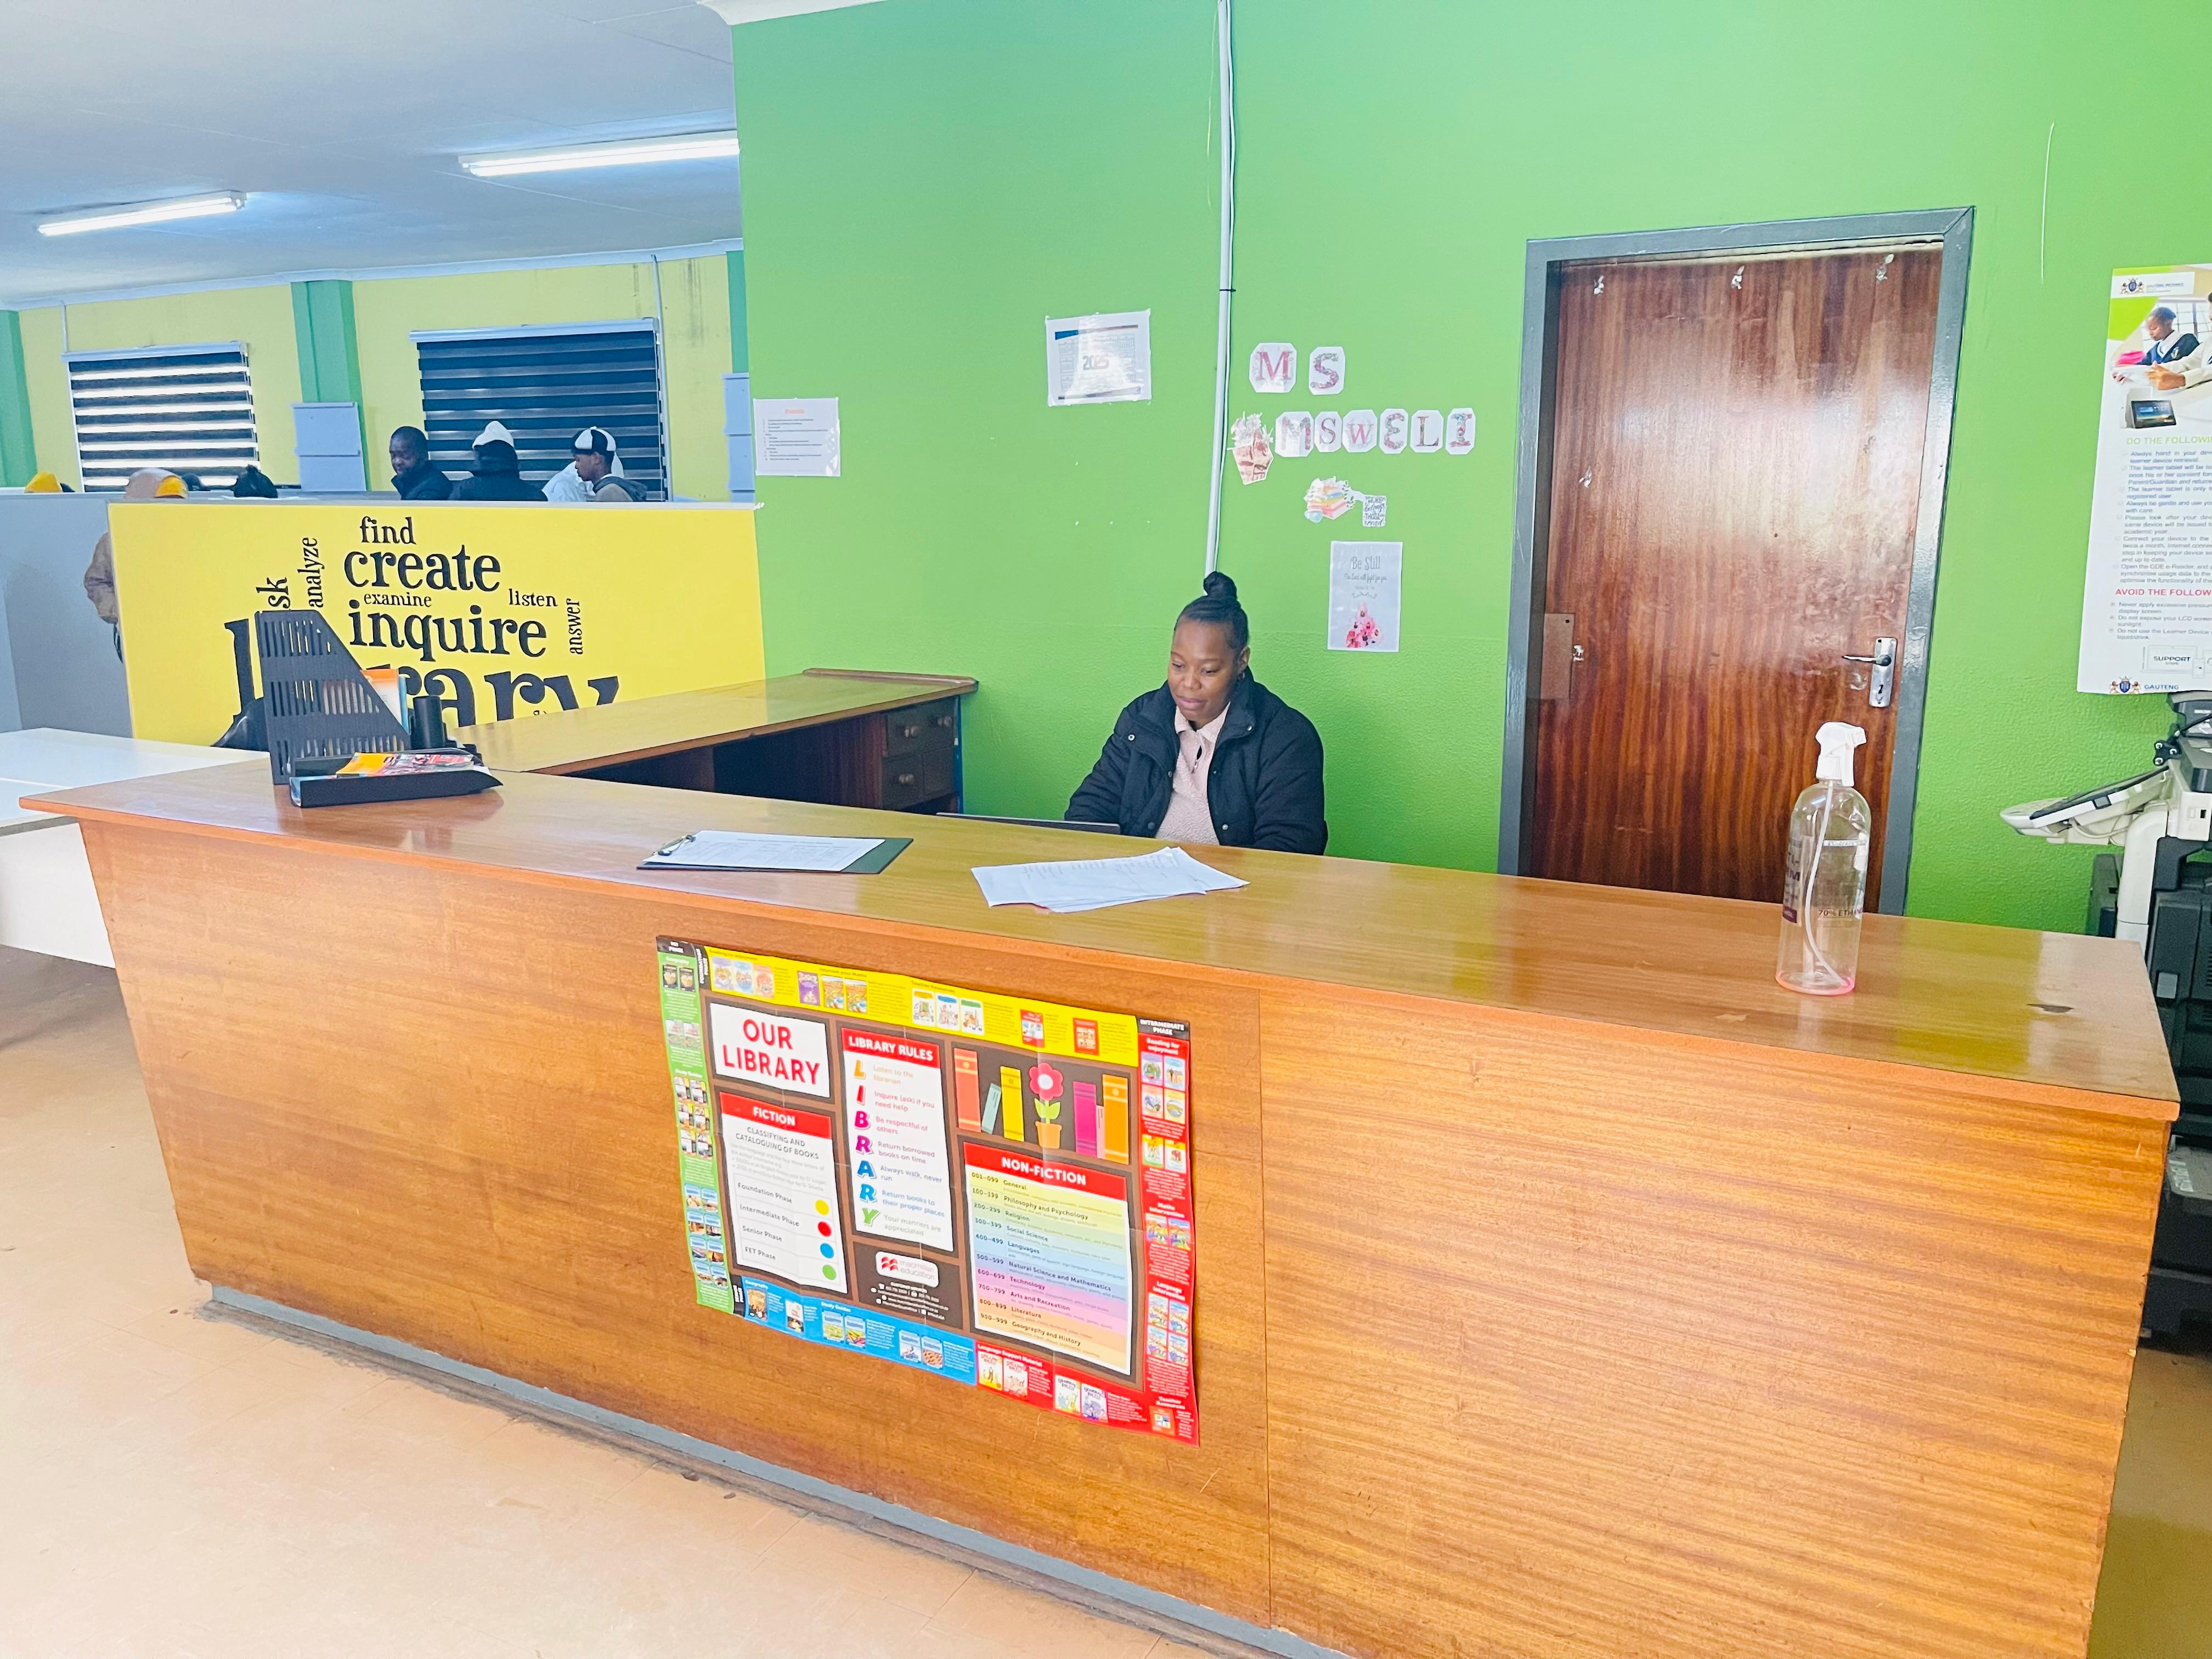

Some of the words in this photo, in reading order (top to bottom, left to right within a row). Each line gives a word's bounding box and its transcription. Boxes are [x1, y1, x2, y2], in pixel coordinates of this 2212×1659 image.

[1282, 413, 1472, 450] MSWELI
[360, 516, 416, 545] find
[344, 544, 500, 592] create
[1351, 556, 1362, 569] Be
[1365, 556, 1380, 570] Still
[297, 537, 324, 608] analyze
[256, 577, 291, 609] sk
[364, 592, 432, 607] examine
[509, 589, 558, 607] listen
[348, 599, 547, 662] inquire
[569, 598, 583, 655] answer
[1140, 1019, 1184, 1031] INTERMEDIATE
[1153, 1027, 1173, 1036] PHASE
[743, 1019, 793, 1050] OUR
[849, 1036, 896, 1053] LIBRARY
[899, 1045, 933, 1061] RULES
[723, 1045, 820, 1085] LIBRARY
[854, 1060, 865, 1078] L
[873, 1065, 893, 1074] Listen
[856, 1085, 865, 1104] I
[874, 1091, 898, 1101] Inquire
[900, 1094, 915, 1104] (ask)
[893, 1102, 908, 1112] help
[753, 1107, 795, 1126] FICTION
[854, 1110, 870, 1129] B
[886, 1119, 919, 1130] respectful
[747, 1127, 788, 1143] CLASSIFYING
[791, 1138, 805, 1147] AND
[876, 1126, 898, 1135] others
[736, 1133, 782, 1151] CATALOGUING
[794, 1148, 819, 1159] BOOKS
[856, 1135, 872, 1154] R
[878, 1141, 901, 1150] Return
[902, 1145, 935, 1158] borrowed
[878, 1150, 899, 1159] books
[912, 1156, 927, 1164] time
[857, 1160, 876, 1178] A
[881, 1165, 904, 1175] Always
[924, 1175, 942, 1183] never
[1001, 1157, 1086, 1186] NON-FICTION
[738, 1182, 774, 1197] Foundation
[775, 1192, 792, 1204] Phase
[860, 1183, 877, 1202] R
[1003, 1180, 1027, 1190] General
[882, 1190, 905, 1199] Return
[906, 1194, 927, 1204] books
[928, 1198, 935, 1206] to
[740, 1204, 780, 1221] Intermediate
[782, 1216, 799, 1227] Phase
[862, 1207, 880, 1226] Y
[900, 1203, 922, 1212] proper
[924, 1207, 945, 1217] places
[1004, 1195, 1036, 1210] Philosophy
[1052, 1207, 1088, 1220] Psychology
[1005, 1210, 1030, 1222] Religion
[884, 1224, 924, 1236] appreciated
[901, 1218, 929, 1229] manners
[742, 1225, 763, 1235] Senior
[764, 1231, 782, 1242] Phase
[1007, 1226, 1024, 1235] Social
[1026, 1231, 1048, 1242] Science
[758, 1250, 776, 1260] Phase
[1008, 1241, 1040, 1254] Languages
[900, 1267, 935, 1280] education
[1009, 1261, 1032, 1272] Natural
[1034, 1267, 1056, 1278] Science
[1071, 1277, 1111, 1291] Mathematics
[1010, 1276, 1045, 1290] Technology
[1011, 1291, 1022, 1300] Arts
[1037, 1297, 1070, 1311] Recreation
[1011, 1306, 1042, 1318] Literature
[1012, 1321, 1045, 1336] Geography
[1046, 1331, 1057, 1339] and
[1059, 1335, 1081, 1346] History
